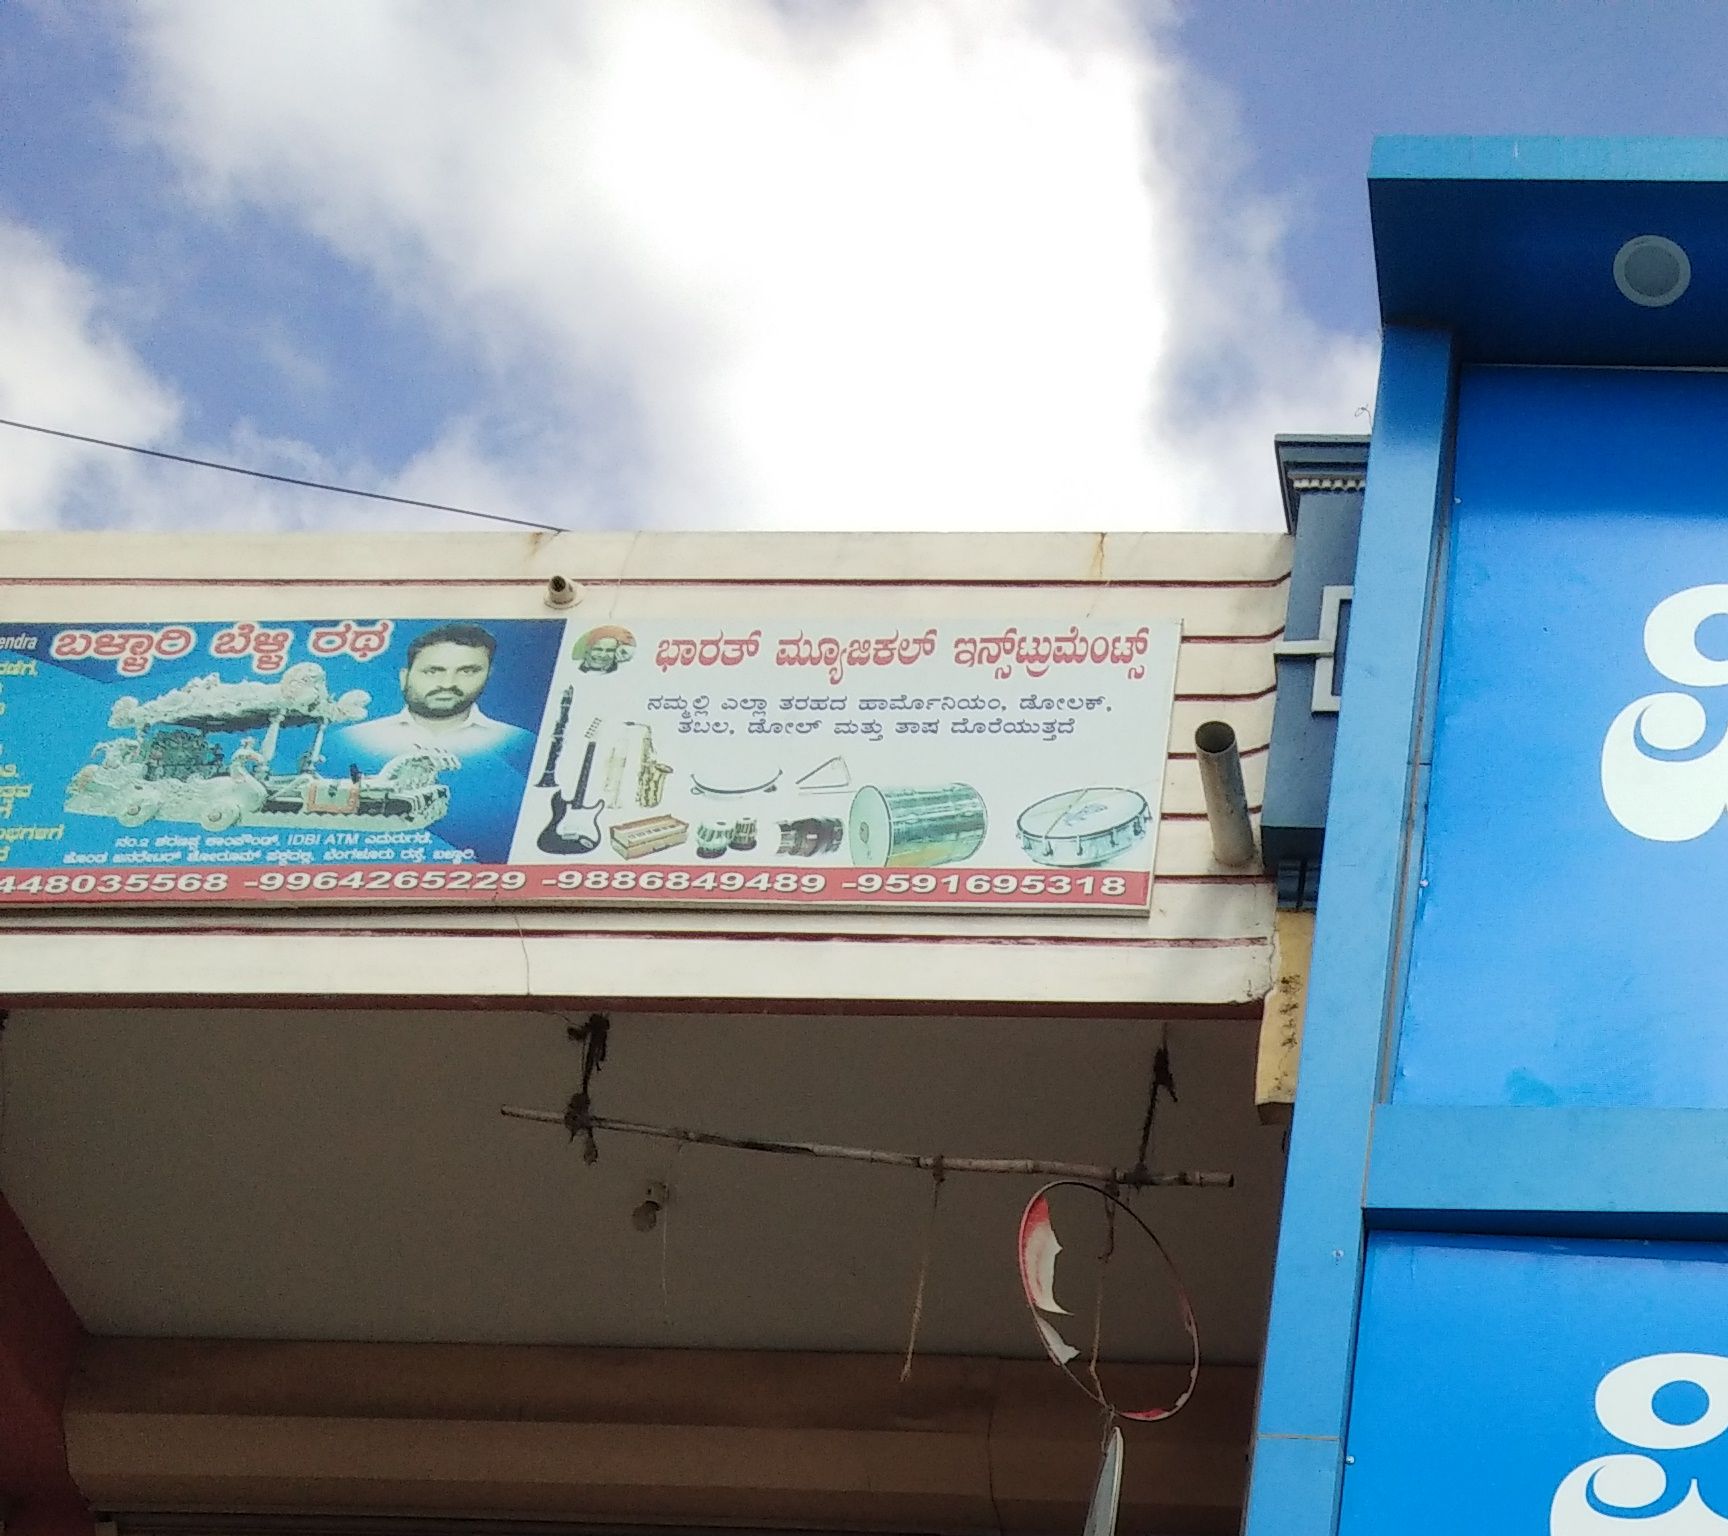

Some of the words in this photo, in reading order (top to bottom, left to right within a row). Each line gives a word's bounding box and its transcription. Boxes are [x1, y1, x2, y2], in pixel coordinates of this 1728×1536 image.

[310, 620, 391, 660] ರಥ
[655, 629, 762, 673] ಭಾರತ್
[647, 694, 710, 718] ನಮ್ಮಲ್ಲಿ
[720, 695, 768, 718] ಎಲ್ಲಾ
[779, 695, 848, 711] ತರಹದ
[747, 718, 822, 734] ಡೋಲ್
[833, 719, 884, 741] ಮತ್ತು
[950, 718, 1076, 741] ದೊರೆಯುತ್ತದೆ
[323, 833, 360, 846] ATM
